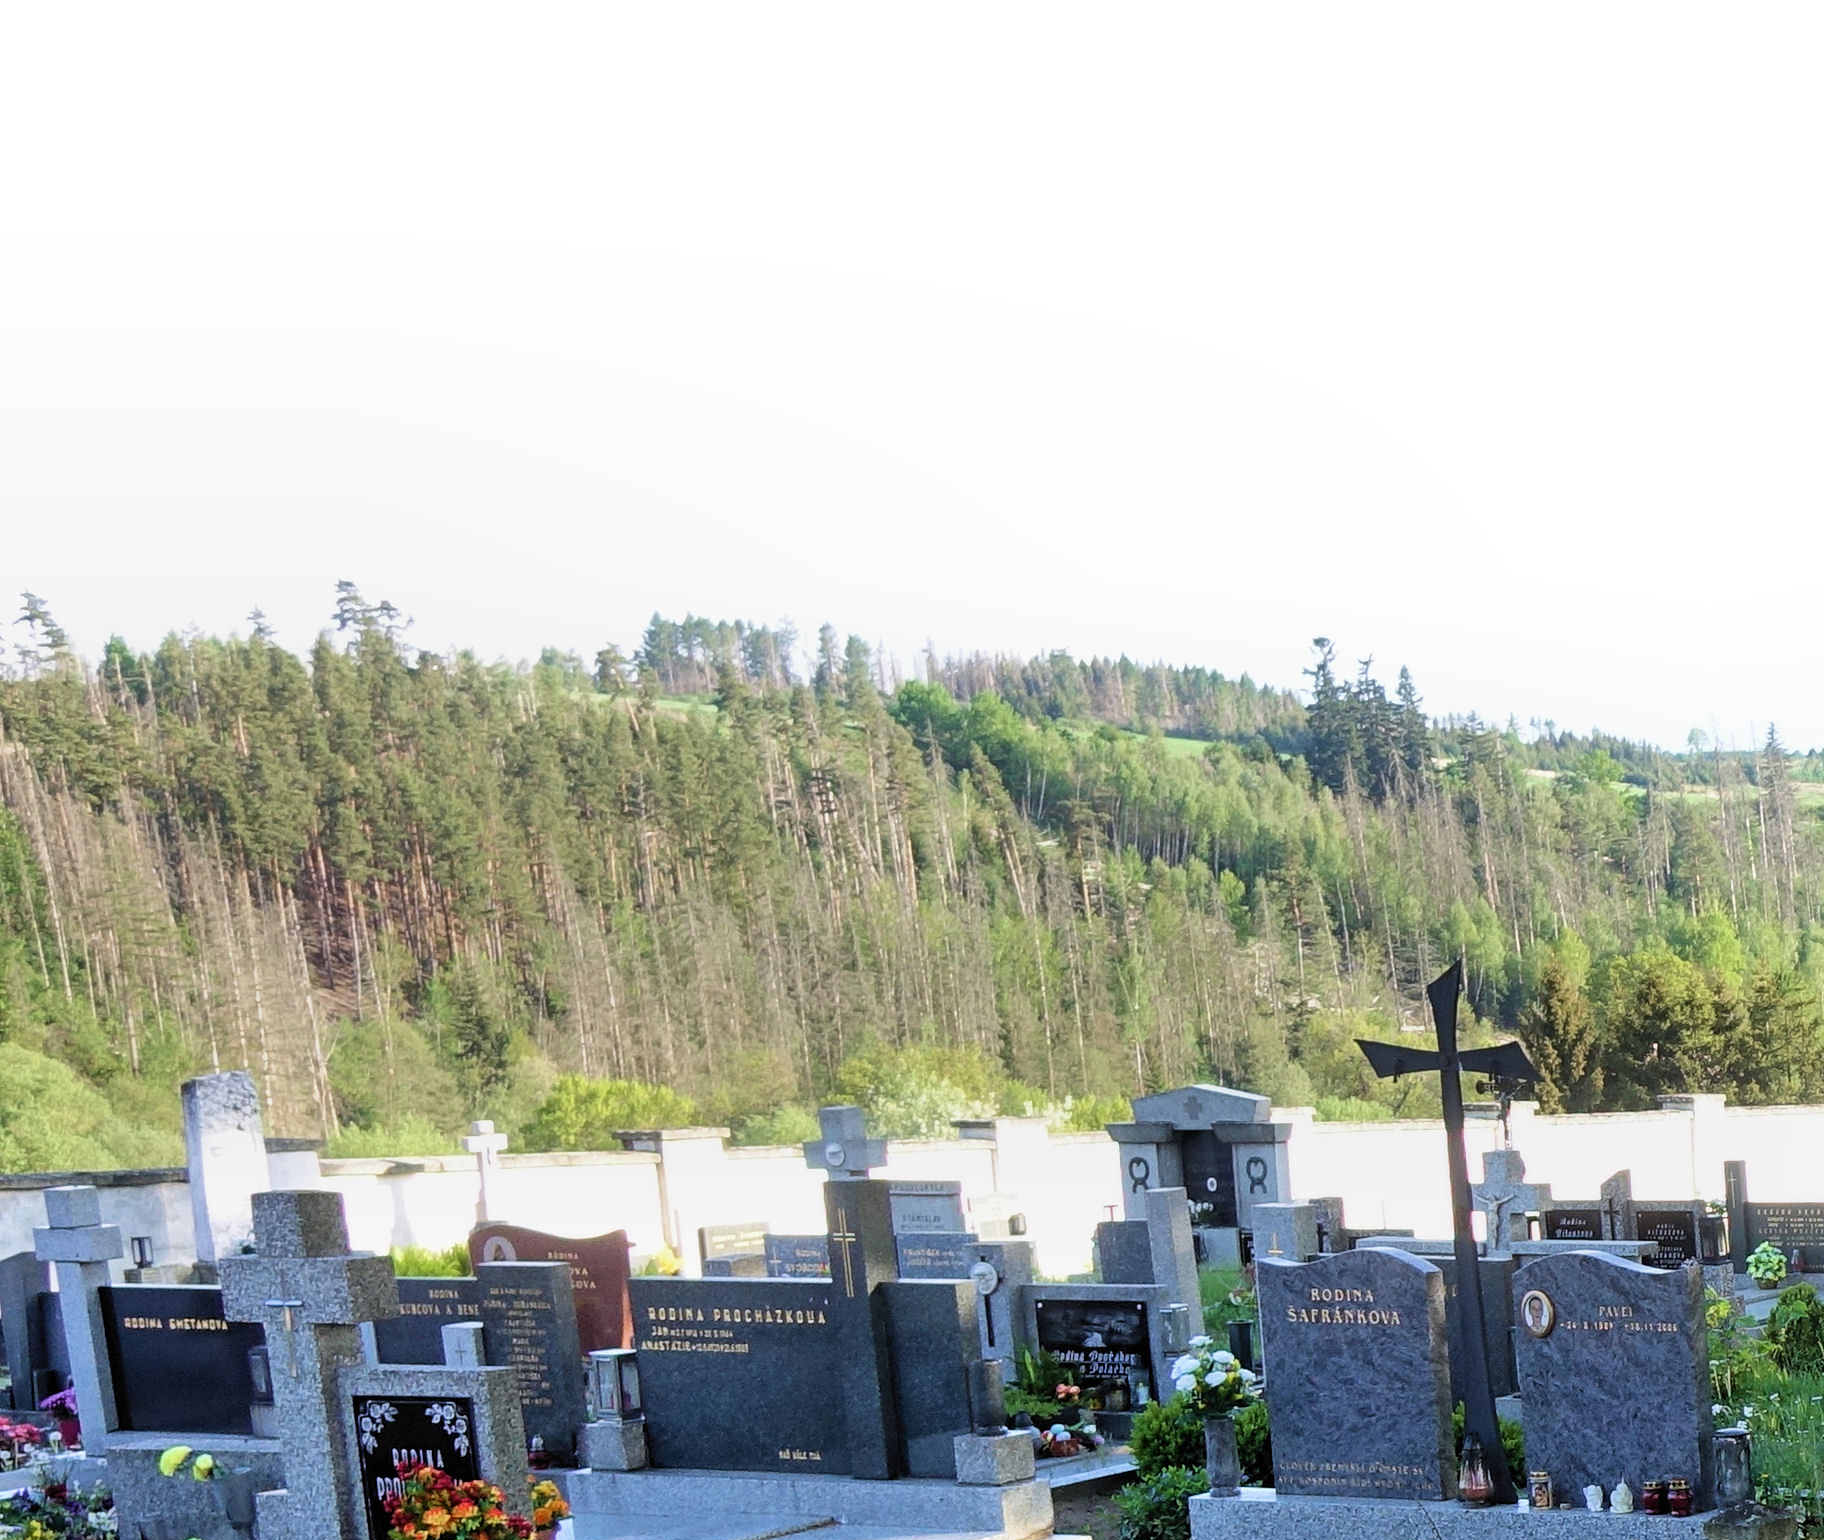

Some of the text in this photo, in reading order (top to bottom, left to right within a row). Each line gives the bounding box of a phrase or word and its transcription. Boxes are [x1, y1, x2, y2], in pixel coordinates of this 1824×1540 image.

[1310, 1287, 1375, 1303] RODINA
[647, 1306, 705, 1322] RODINA
[1287, 1304, 1401, 1326] ŠAFRÁNKOVA
[123, 1317, 163, 1329] RODINA
